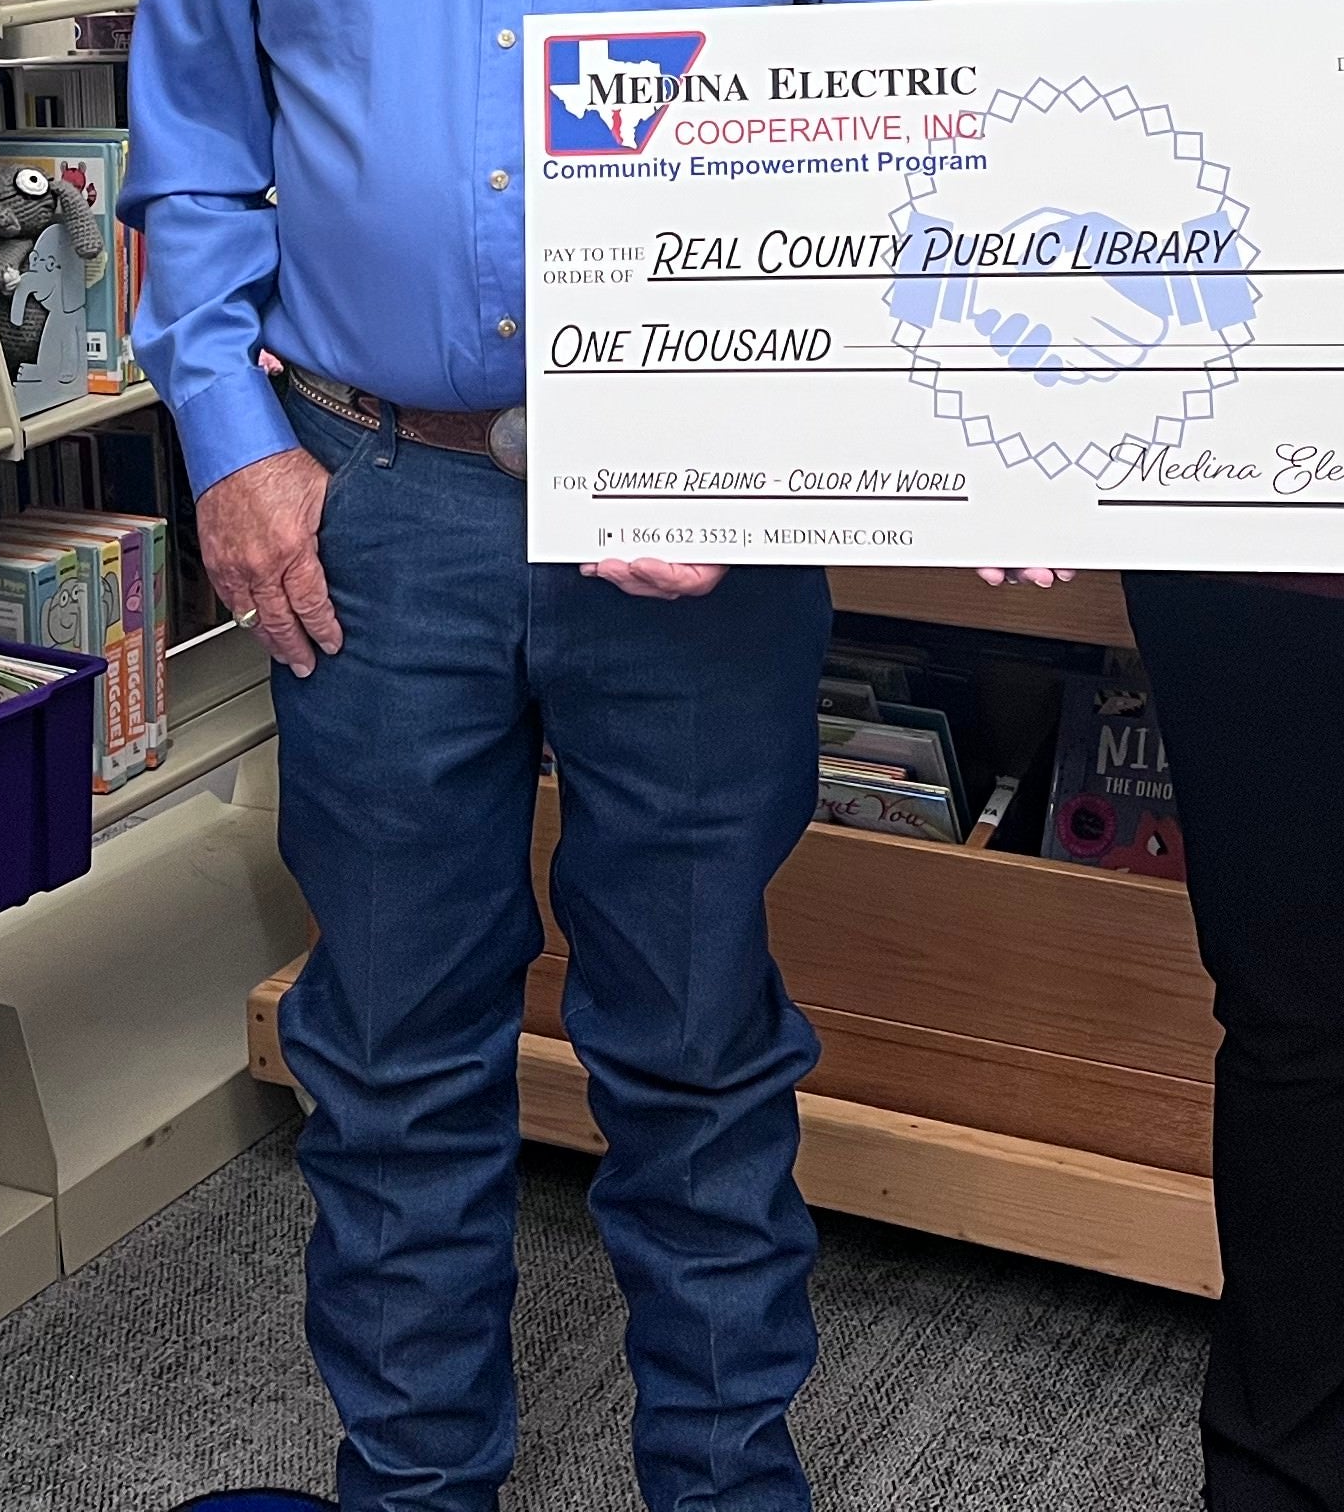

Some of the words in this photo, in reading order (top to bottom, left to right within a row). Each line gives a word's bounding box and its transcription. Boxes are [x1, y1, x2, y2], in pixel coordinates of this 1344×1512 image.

[585, 70, 749, 106] MEDINA
[766, 66, 978, 100] ELECTRIC
[674, 117, 912, 147] COOPERATIVE,
[923, 113, 986, 141] INC.
[543, 158, 681, 182] Community
[690, 153, 869, 179] Empowerment
[878, 151, 988, 177] Program
[543, 247, 576, 263] PAY
[580, 247, 605, 261] TO
[609, 245, 646, 261] THE
[543, 269, 604, 285] ORDER
[606, 269, 633, 283] OF
[653, 231, 743, 277] REAL
[758, 229, 912, 275] COUNTY
[922, 226, 1061, 272] PUBLIC
[1071, 225, 1238, 270] LIBRARY
[550, 324, 632, 368] ONE
[639, 323, 832, 367] THOUSAND
[553, 475, 587, 492] FOR
[593, 469, 677, 493] SUMMER
[683, 469, 767, 492] READING
[788, 469, 853, 492] COLOR
[856, 469, 893, 492] MY
[896, 470, 966, 493] WORLD
[1097, 443, 1262, 491] Medina
[632, 528, 662, 545] 866
[666, 528, 695, 545] 632
[700, 528, 737, 545] 3532
[762, 529, 914, 547] MEDINAEC.ORG
[1105, 777, 1131, 796] THE
